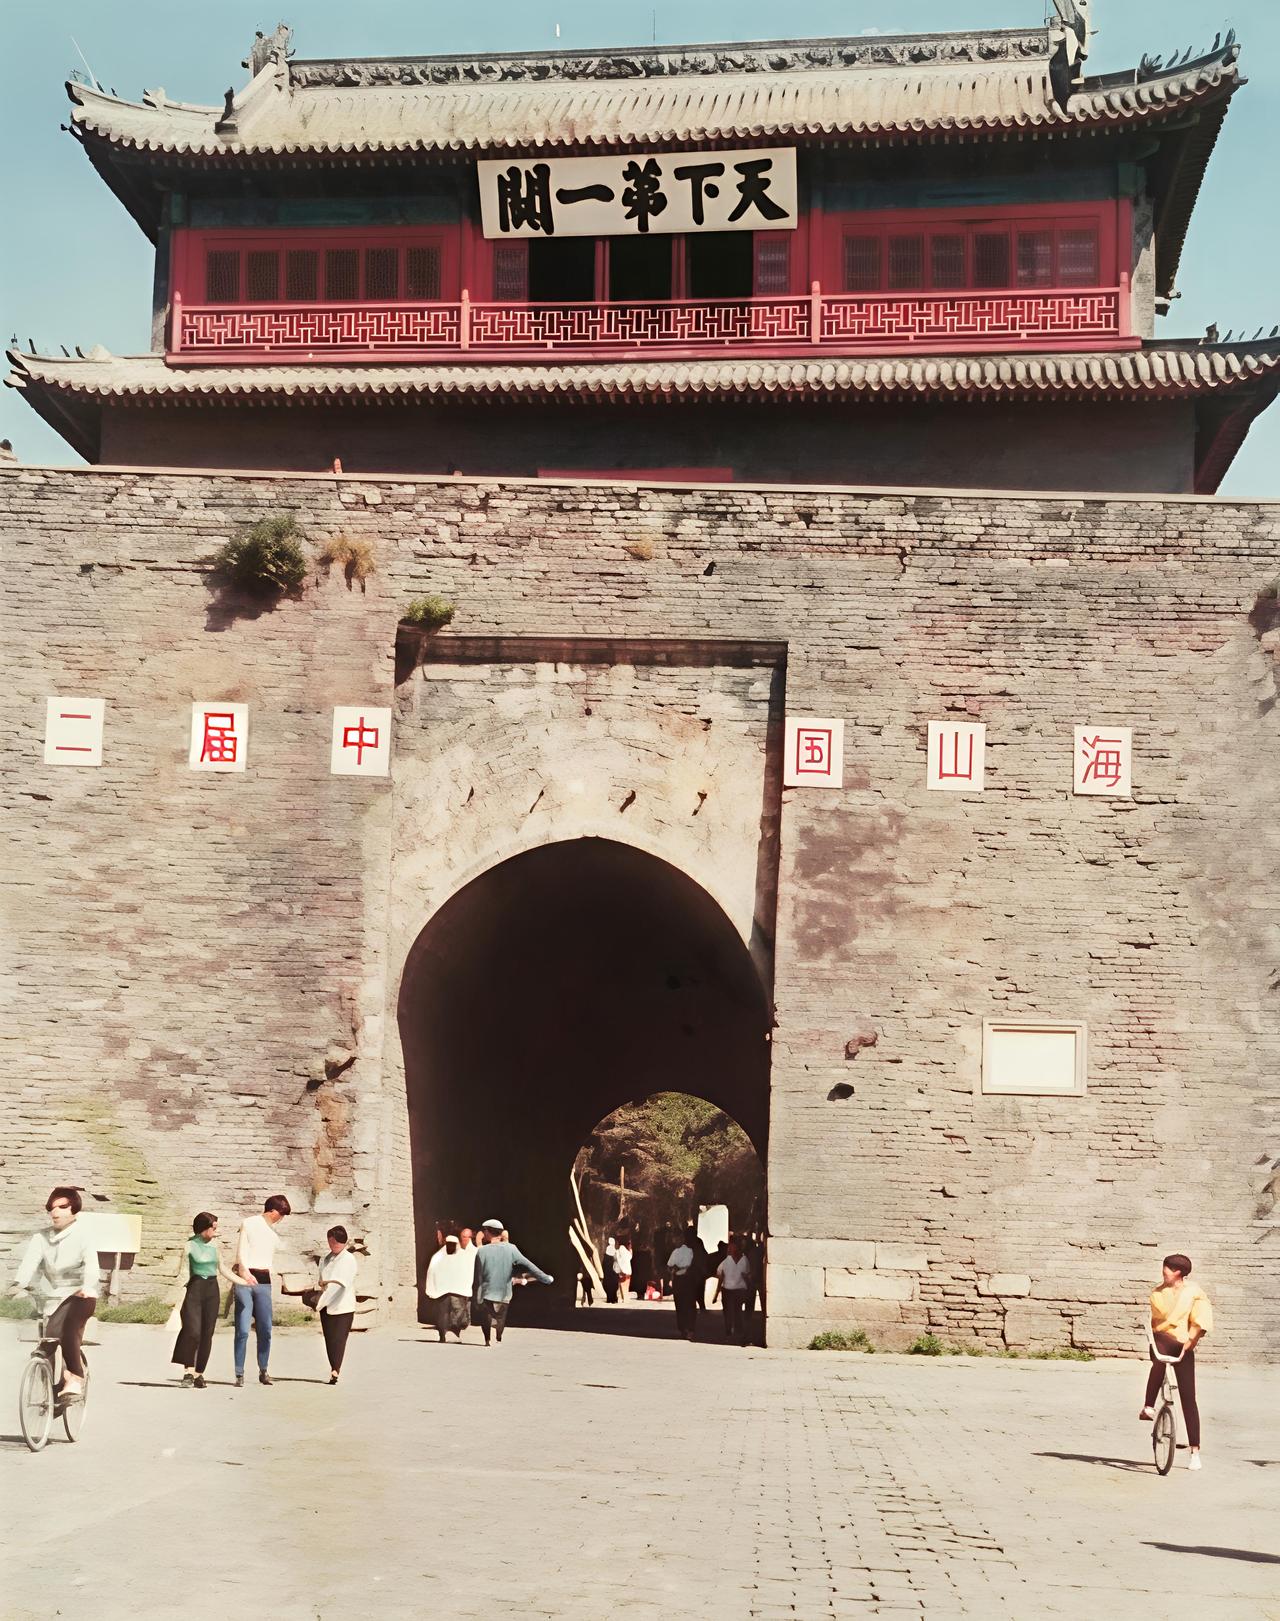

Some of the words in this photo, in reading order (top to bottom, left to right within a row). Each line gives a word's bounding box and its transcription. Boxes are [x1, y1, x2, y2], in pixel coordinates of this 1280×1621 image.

[55, 713, 92, 752] 二
[342, 716, 380, 766] 中
[938, 731, 974, 781] 山
[1082, 735, 1122, 788] 海
